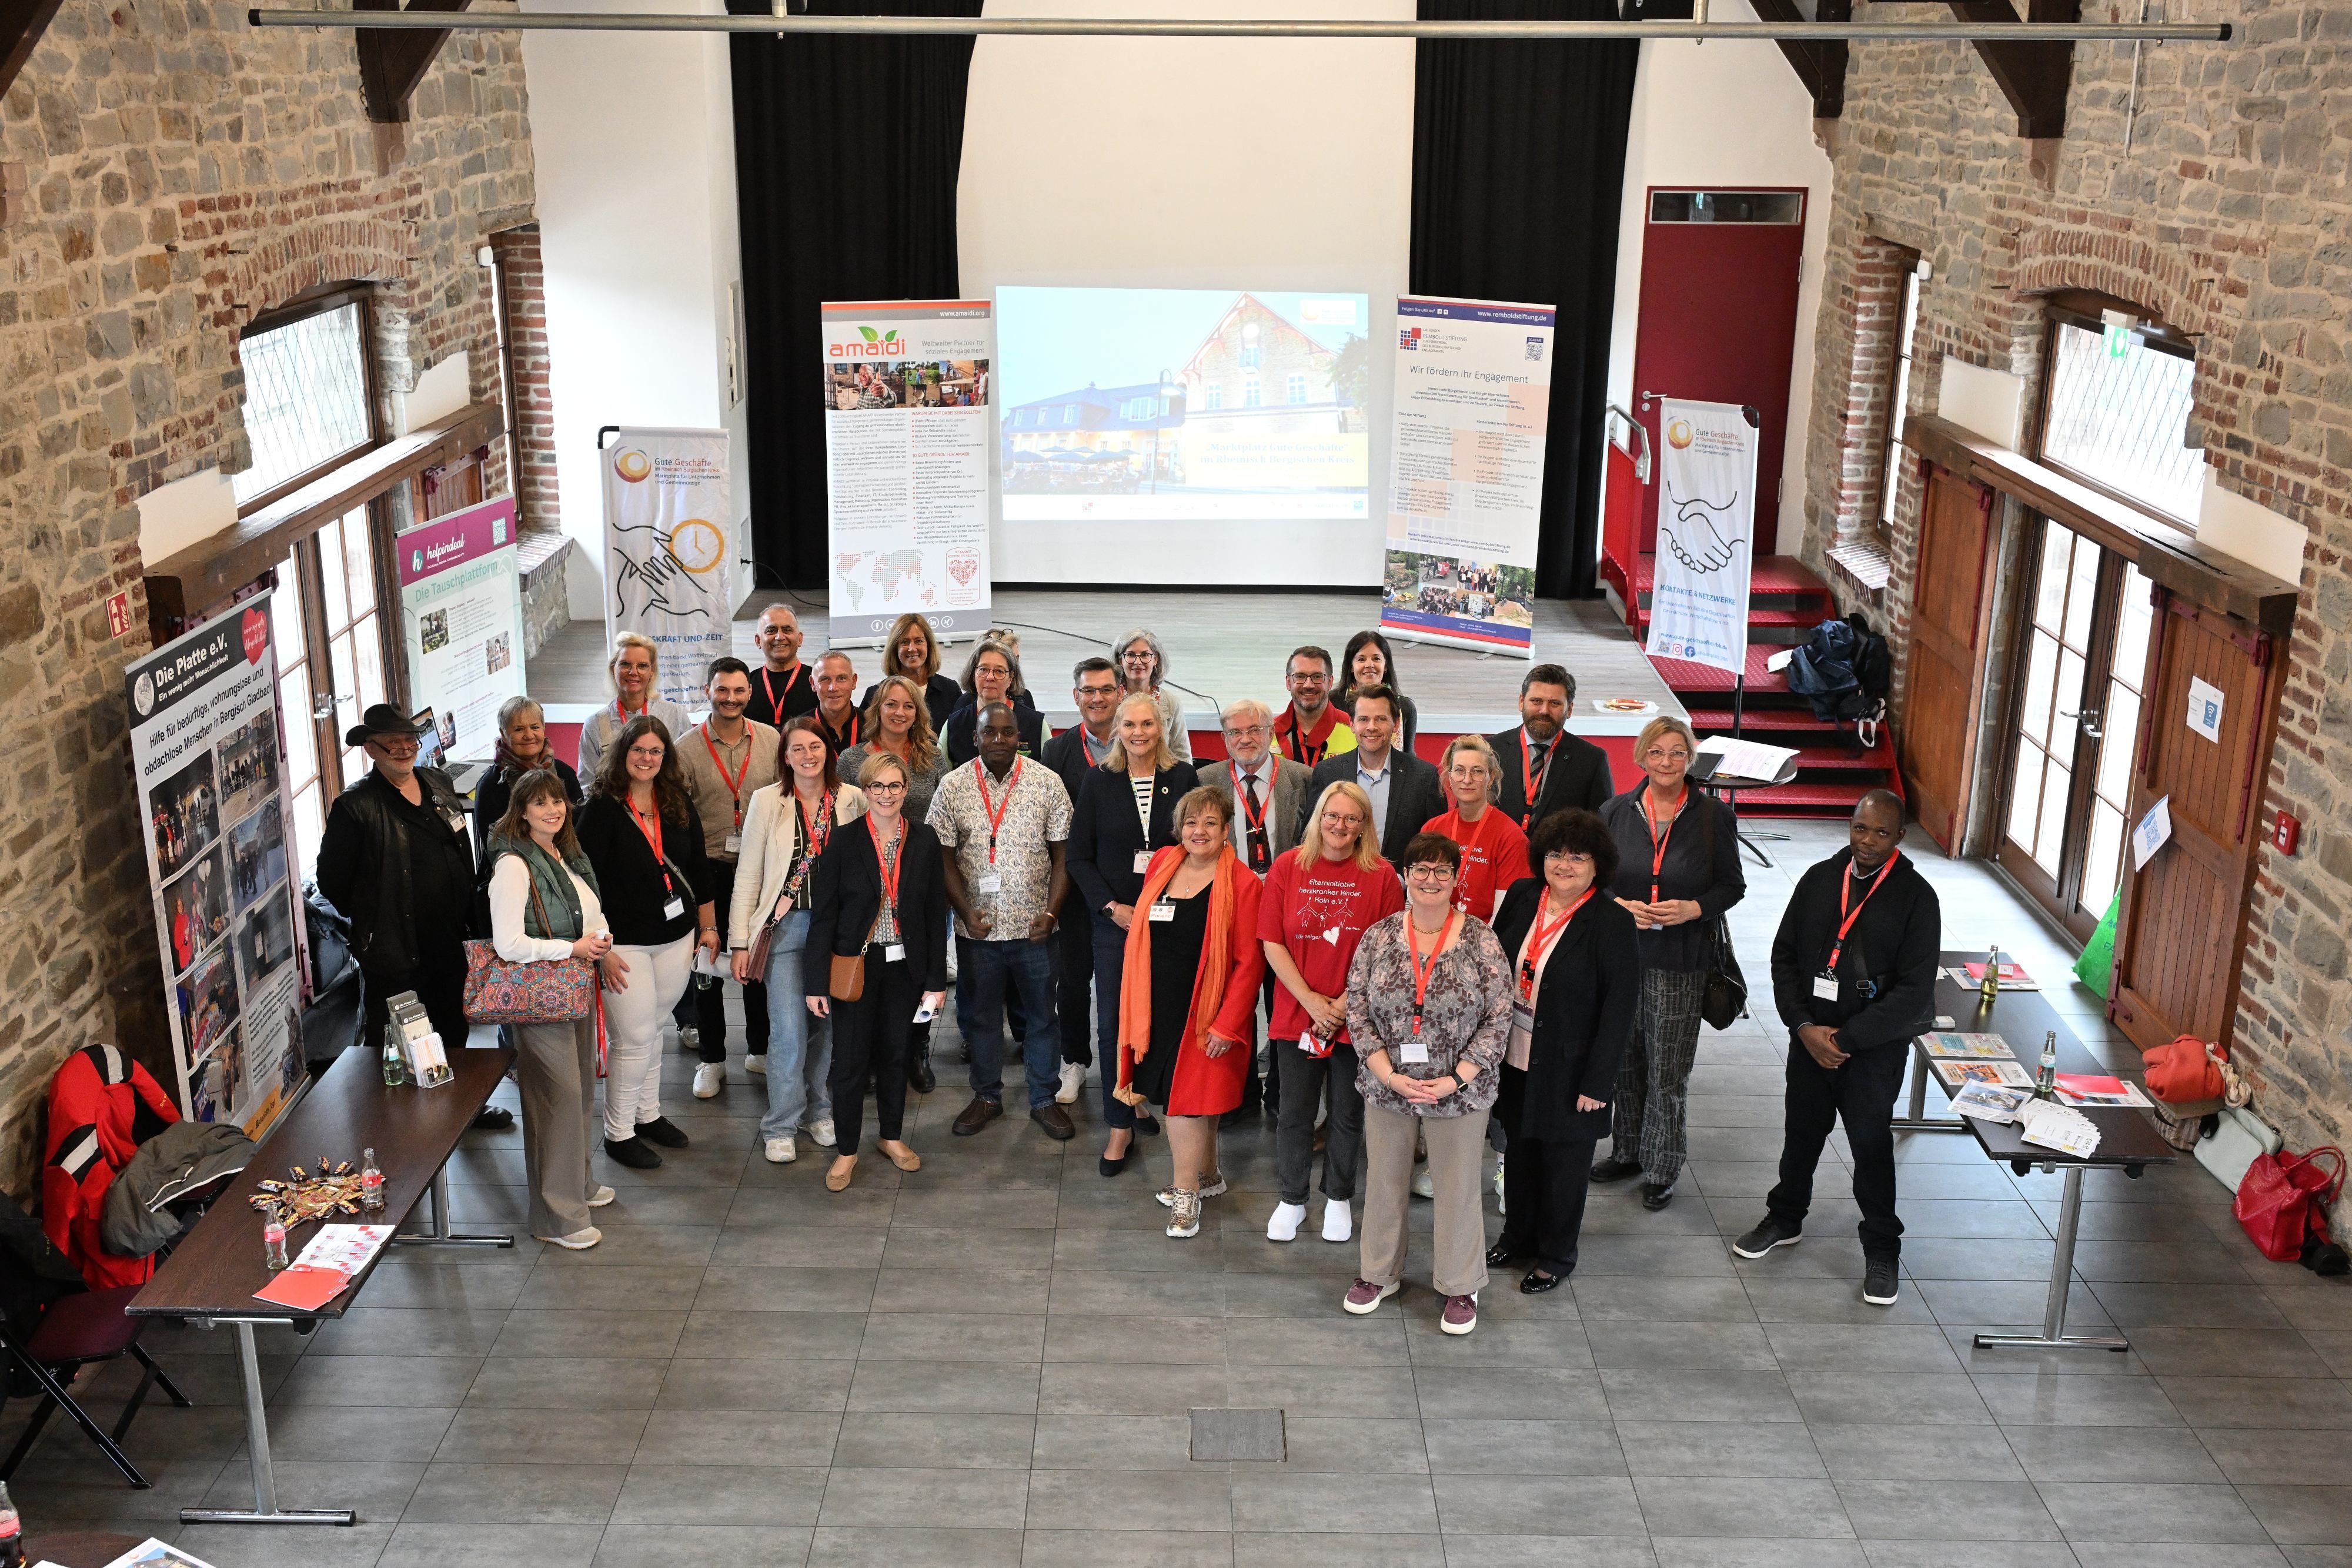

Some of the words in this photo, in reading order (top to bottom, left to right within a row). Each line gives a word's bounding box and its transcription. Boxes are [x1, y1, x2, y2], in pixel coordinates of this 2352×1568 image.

[1478, 311, 1546, 321] www.remboldstiftung.de
[829, 339, 905, 356] amaidi
[1410, 365, 1424, 374] Wir
[1426, 367, 1458, 377] fördern
[1461, 370, 1472, 378] Ihr
[1475, 371, 1528, 383] Engagement
[1710, 431, 1738, 440] Geschäfte
[1270, 443, 1293, 452] Gute
[1200, 455, 1213, 463] im
[1216, 455, 1266, 463] Rheinisch
[1269, 455, 1325, 464] Bergischen
[427, 533, 465, 562] helpindeal
[1460, 544, 1509, 553] vorstand@remboldstiftung.de
[447, 553, 465, 562] COMMUNITY
[415, 587, 429, 603] Die
[431, 560, 498, 595] Tauschplattform
[1661, 584, 1692, 596] KONTAKTE
[1699, 592, 1736, 606] NETZWERKE
[1709, 610, 1735, 619] Organisation
[684, 634, 723, 643] UND-ZEIT
[1661, 632, 1728, 650] www.gute-geschaefte-rbk.de
[155, 666, 175, 688] Die
[176, 648, 207, 676] Platte
[209, 633, 228, 656] e.V.
[158, 691, 168, 702] Ein
[168, 683, 182, 696] wenig
[183, 675, 195, 687] mehr
[195, 654, 229, 680] Menschlichkeit
[149, 731, 165, 748] Hilfe
[166, 723, 176, 738] für
[177, 703, 209, 731] bedürftige,
[210, 677, 251, 708] wohnungslose
[252, 666, 263, 681] und
[145, 744, 183, 776] obdachlose
[183, 722, 213, 751] Menschen
[213, 718, 219, 729] in
[220, 699, 246, 724] Bergisch
[247, 681, 273, 706] Gladbach
[1309, 879, 1355, 887] Elterninitiative
[1299, 887, 1339, 895] herzkranker
